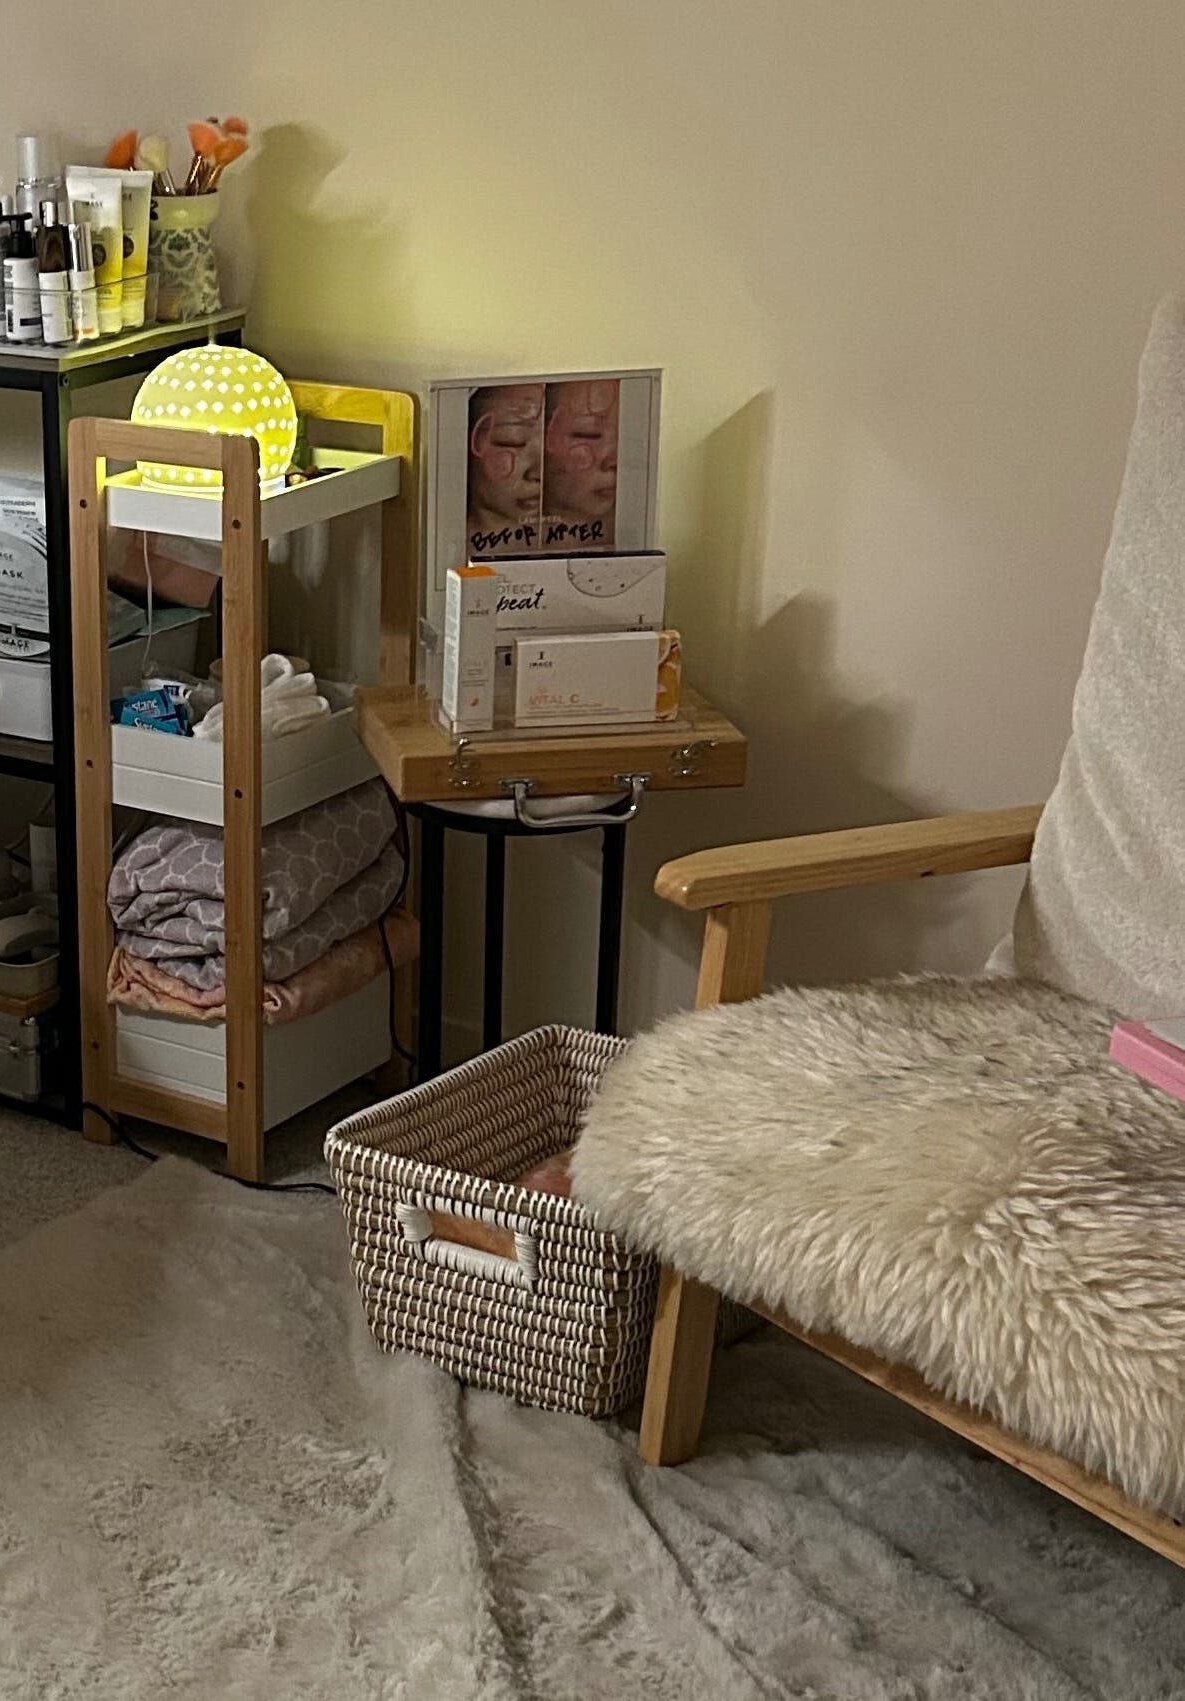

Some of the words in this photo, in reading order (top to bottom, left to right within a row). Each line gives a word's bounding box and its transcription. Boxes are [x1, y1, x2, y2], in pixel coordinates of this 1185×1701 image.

[545, 520, 604, 545] AFTER
[529, 660, 553, 668] IMAGE
[528, 694, 563, 704] VITAL
[570, 693, 580, 704] C
